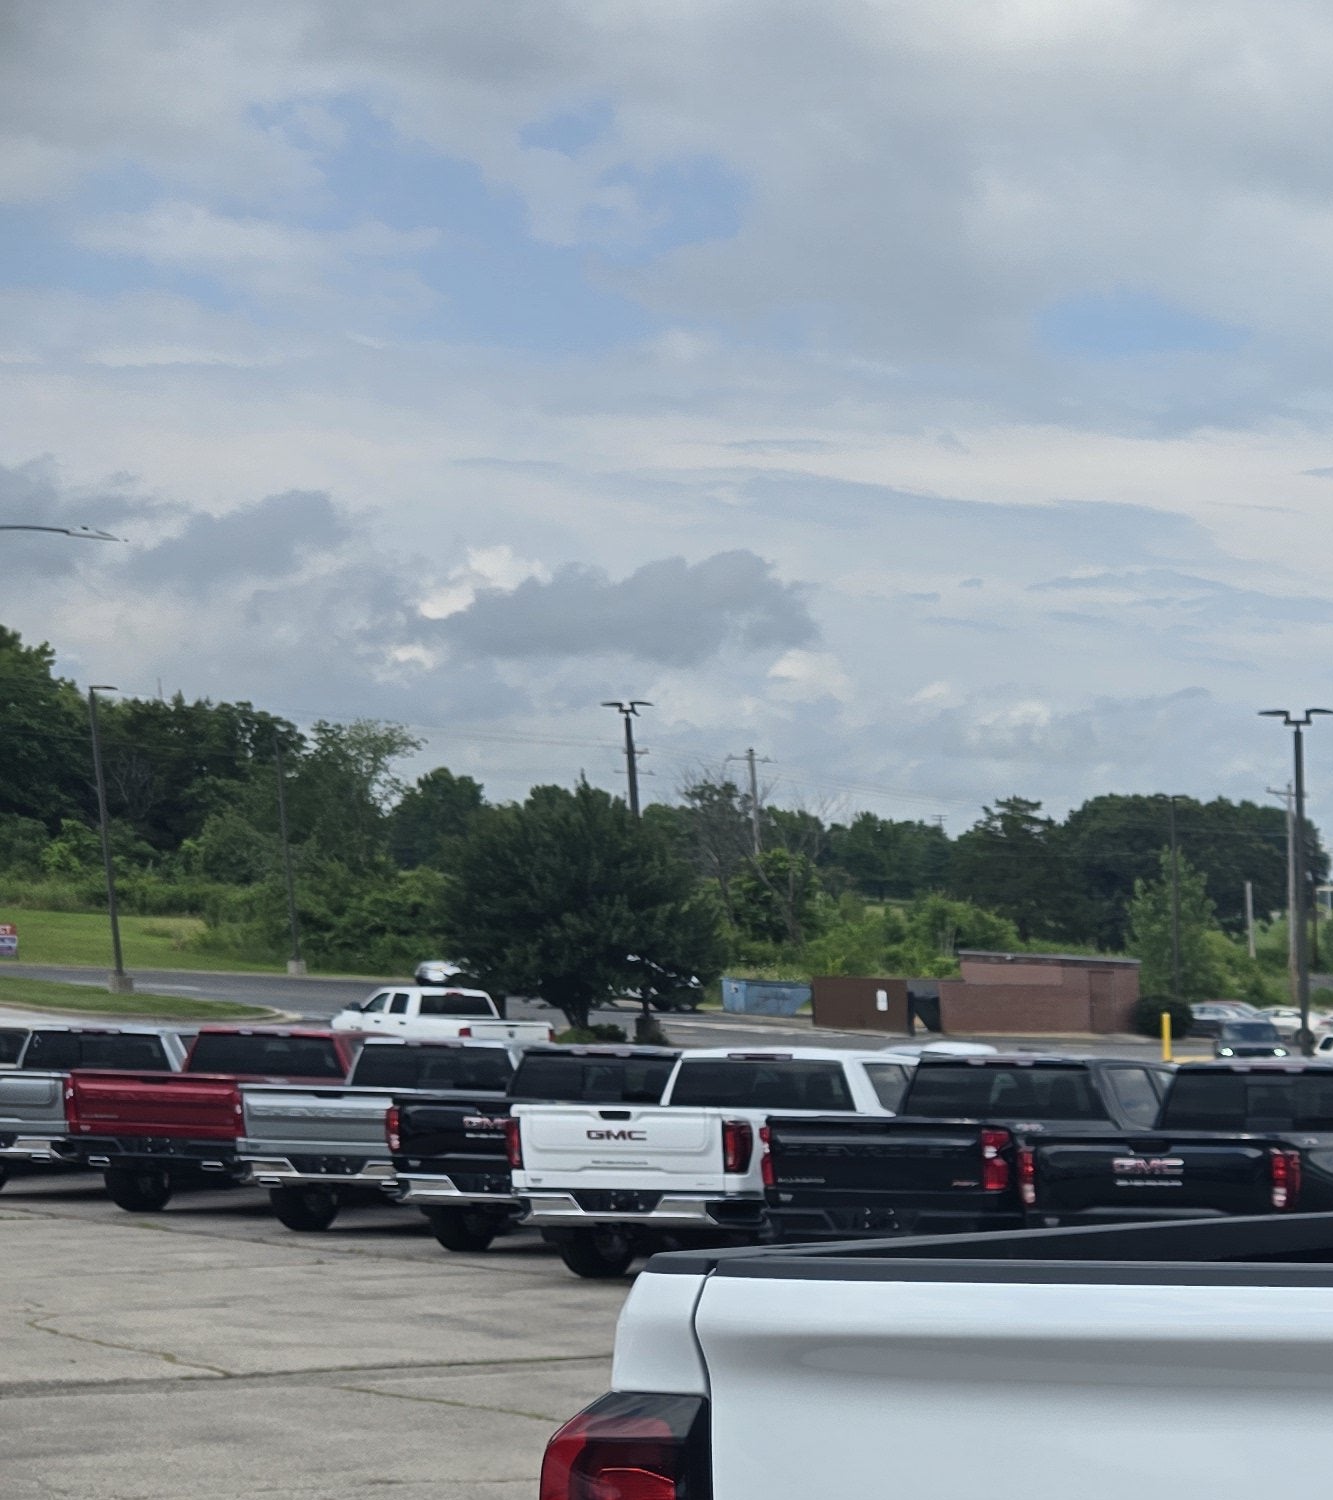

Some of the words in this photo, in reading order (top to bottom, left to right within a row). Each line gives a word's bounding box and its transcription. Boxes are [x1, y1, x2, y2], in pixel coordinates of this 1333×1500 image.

[463, 1116, 508, 1130] GM
[586, 1129, 648, 1141] GMC
[1112, 1157, 1185, 1175] GMC
